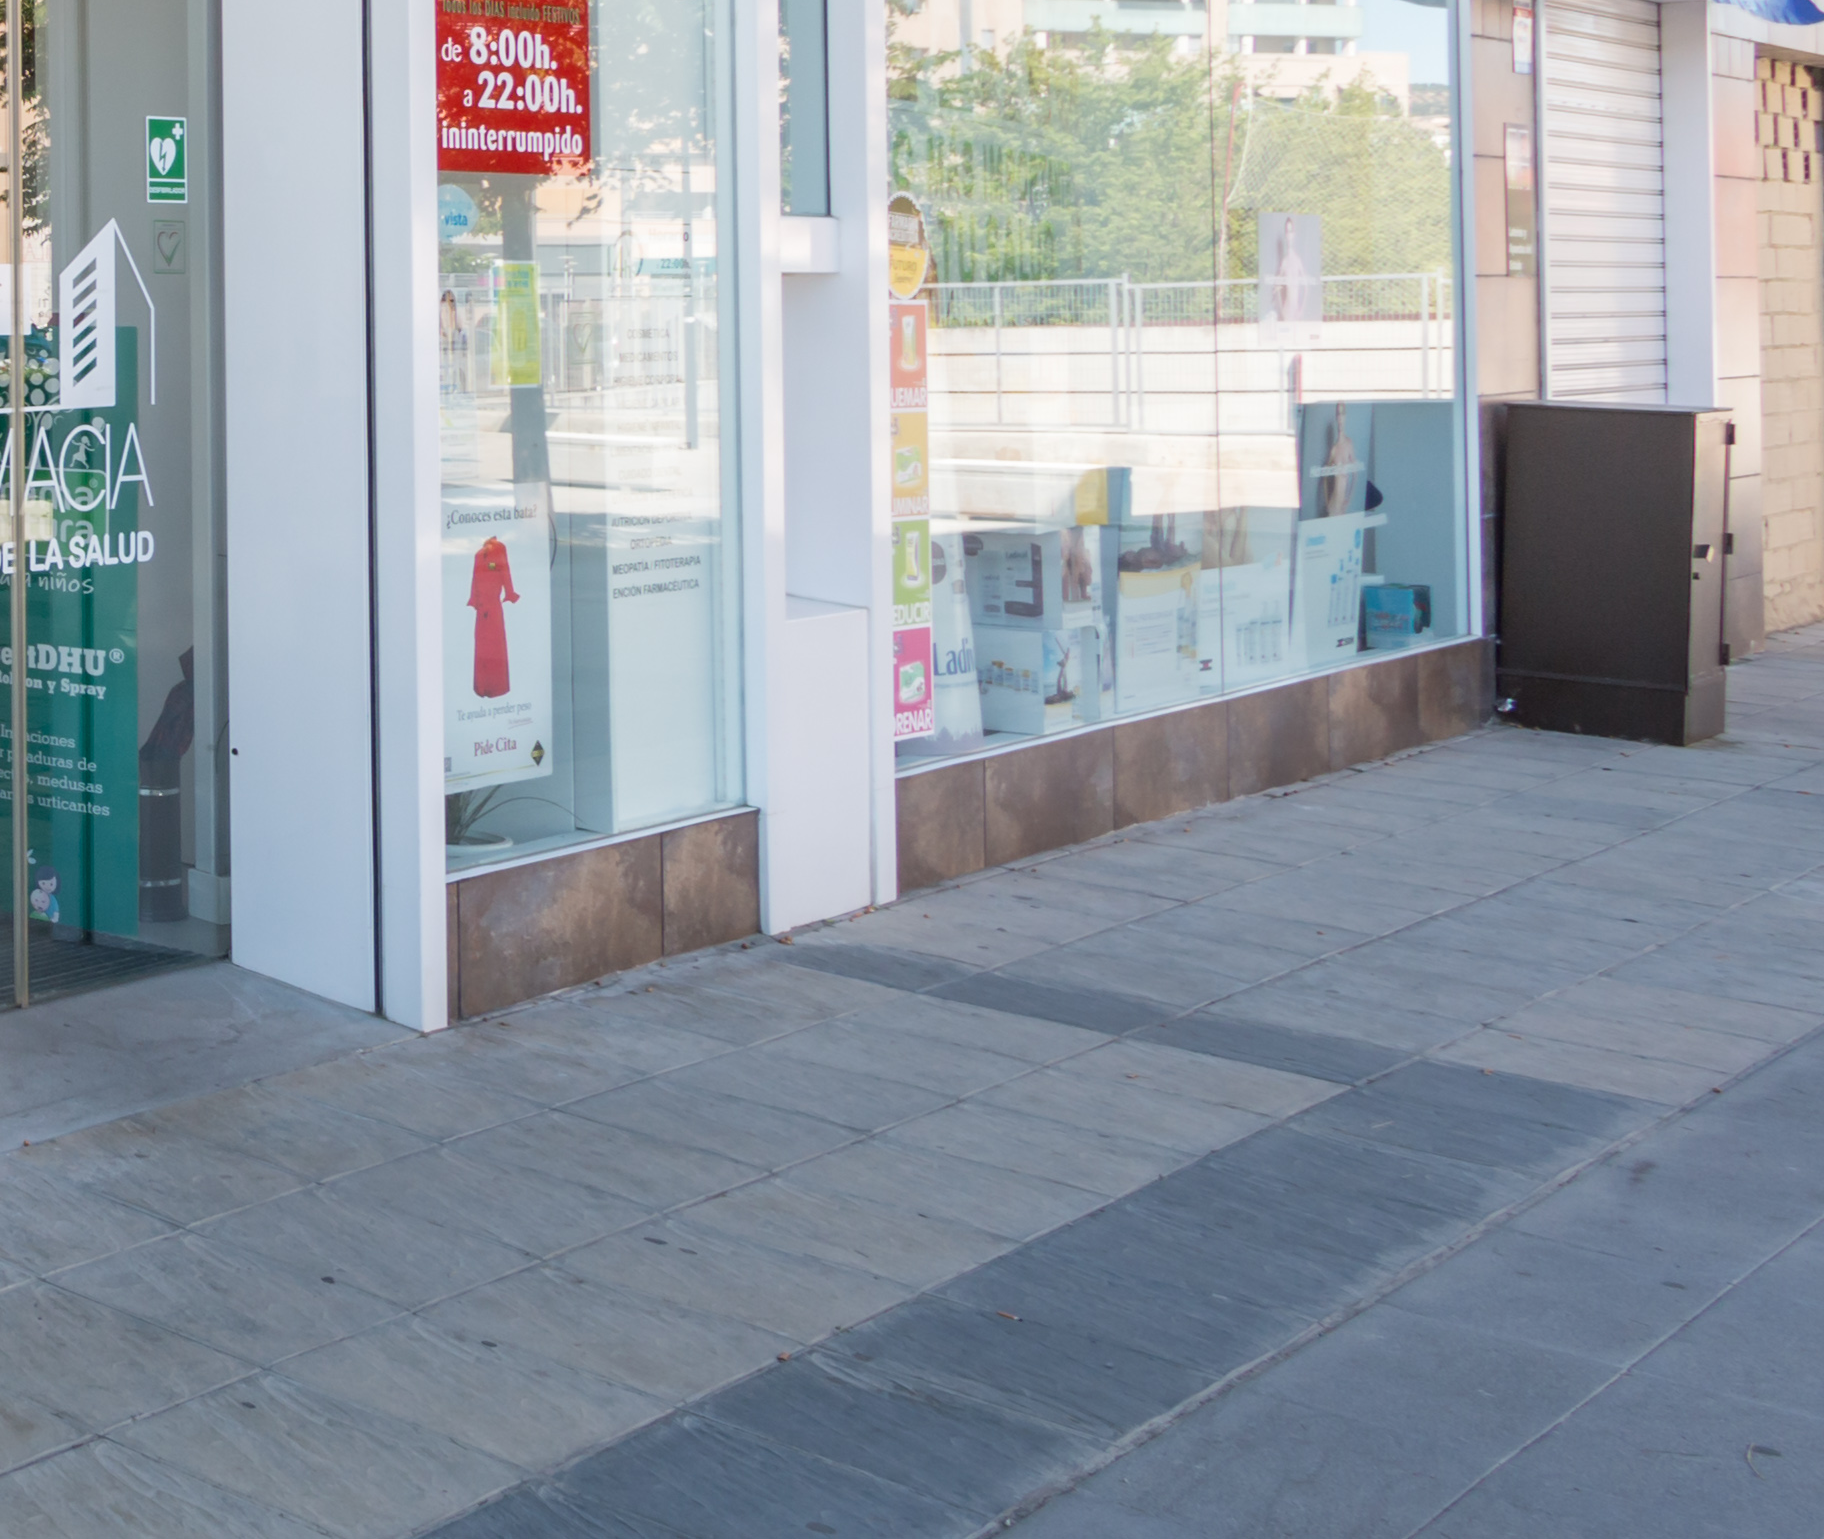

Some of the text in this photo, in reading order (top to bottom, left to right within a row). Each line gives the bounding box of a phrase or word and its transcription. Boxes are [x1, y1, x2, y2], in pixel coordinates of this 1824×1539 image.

[441, 26, 558, 70] de 8:00h.
[462, 71, 583, 115] a 22:00h.
[442, 120, 583, 161] ininterrumpido
[444, 213, 468, 227] vista
[446, 504, 537, 530] ¿Conoces esta bata?
[29, 537, 64, 572] LA
[68, 530, 155, 569] SALUD
[654, 555, 702, 572] FITOTERAPIA
[38, 571, 95, 595] niños
[643, 578, 700, 595] FARMACÉUTICA
[47, 678, 107, 700] y Spray
[457, 708, 466, 722] Te
[467, 707, 486, 722] ayuda
[493, 703, 515, 719] perder
[517, 701, 533, 716] peso
[474, 737, 518, 758] Pide Cita
[77, 758, 98, 772] de
[37, 774, 104, 795] medusas
[37, 794, 111, 817] urticantes
